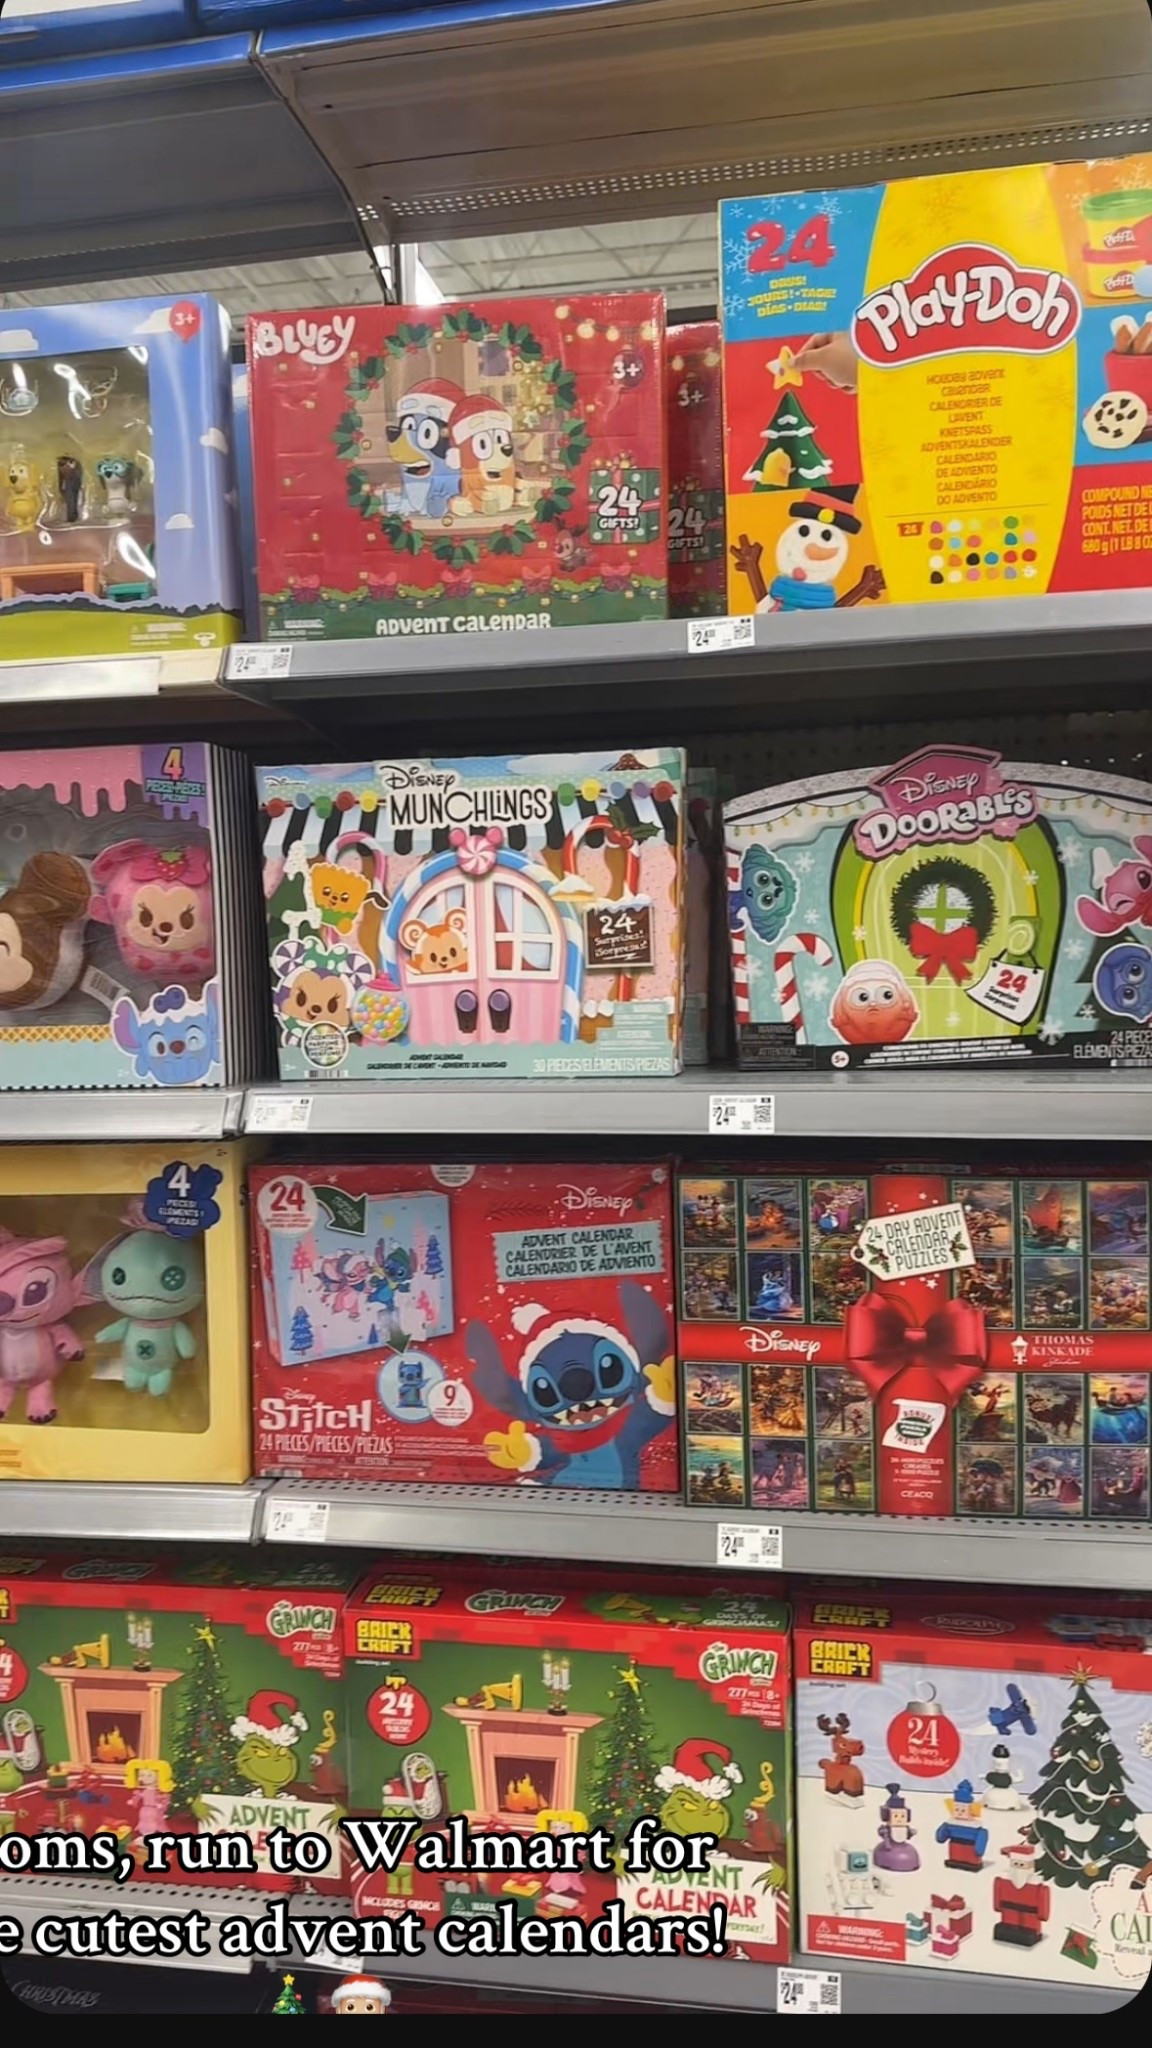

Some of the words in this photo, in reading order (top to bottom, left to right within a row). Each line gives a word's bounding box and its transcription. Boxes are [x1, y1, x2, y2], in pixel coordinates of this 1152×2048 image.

[748, 213, 836, 274] 24
[856, 265, 1070, 353] Play-Doh
[256, 315, 355, 365] BLUEY
[612, 361, 641, 380] 3+
[678, 389, 704, 407] 3+
[921, 436, 1013, 452] ADVENTSKALENDER
[936, 468, 949, 478] DE
[951, 464, 998, 476] ADVIENTO
[598, 486, 641, 517] 24
[937, 495, 951, 505] DO
[953, 491, 997, 503] ADVENTO
[1082, 486, 1140, 503] COMPOUND
[668, 507, 706, 538] 24
[1082, 504, 1112, 520] POIDS
[1113, 503, 1133, 518] NET
[1134, 502, 1148, 516] DE
[599, 518, 639, 529] GIFTS!
[1134, 518, 1148, 532] DE
[161, 746, 184, 781] 4
[379, 765, 456, 794] Disney
[890, 772, 979, 804] Disney
[390, 788, 548, 825] MUNCHLINGS
[599, 913, 637, 935] 24
[997, 968, 1029, 993] 24
[1110, 1032, 1124, 1045] 24
[167, 1164, 191, 1198] 4
[269, 1181, 305, 1212] 24
[556, 1183, 633, 1218] Disney
[521, 1233, 567, 1248] ADVENT
[571, 1227, 634, 1244] CALENDAR
[866, 1226, 882, 1243] 24
[884, 1219, 911, 1240] DAY
[913, 1209, 961, 1233] ADVENT
[505, 1246, 577, 1263] CALENDRIER
[581, 1244, 599, 1258] DE
[886, 1229, 950, 1257] CALENDAR
[505, 1260, 577, 1277] CALENDARIO
[579, 1258, 598, 1272] DE
[598, 1254, 656, 1270] ADVIENTO
[894, 1247, 949, 1272] PUZZLES
[738, 1326, 821, 1361] Disney
[1031, 1335, 1095, 1345] THOMAS
[1031, 1346, 1095, 1357] KINKADE
[444, 1384, 456, 1407] 9
[259, 1435, 273, 1449] 24
[270, 1609, 334, 1636] GRINCH
[357, 1619, 412, 1639] BRICK
[357, 1637, 412, 1654] CRAFT
[811, 1640, 870, 1661] BRICK
[702, 1651, 776, 1680] GRINCH
[811, 1659, 870, 1677] CRAFT
[379, 1691, 415, 1718] 24
[727, 1687, 747, 1698] 277
[766, 1690, 780, 1700] 8+
[907, 1717, 940, 1747] 24
[229, 1804, 311, 1830] ADVENT
[1114, 1943, 1146, 1957] Reveal
